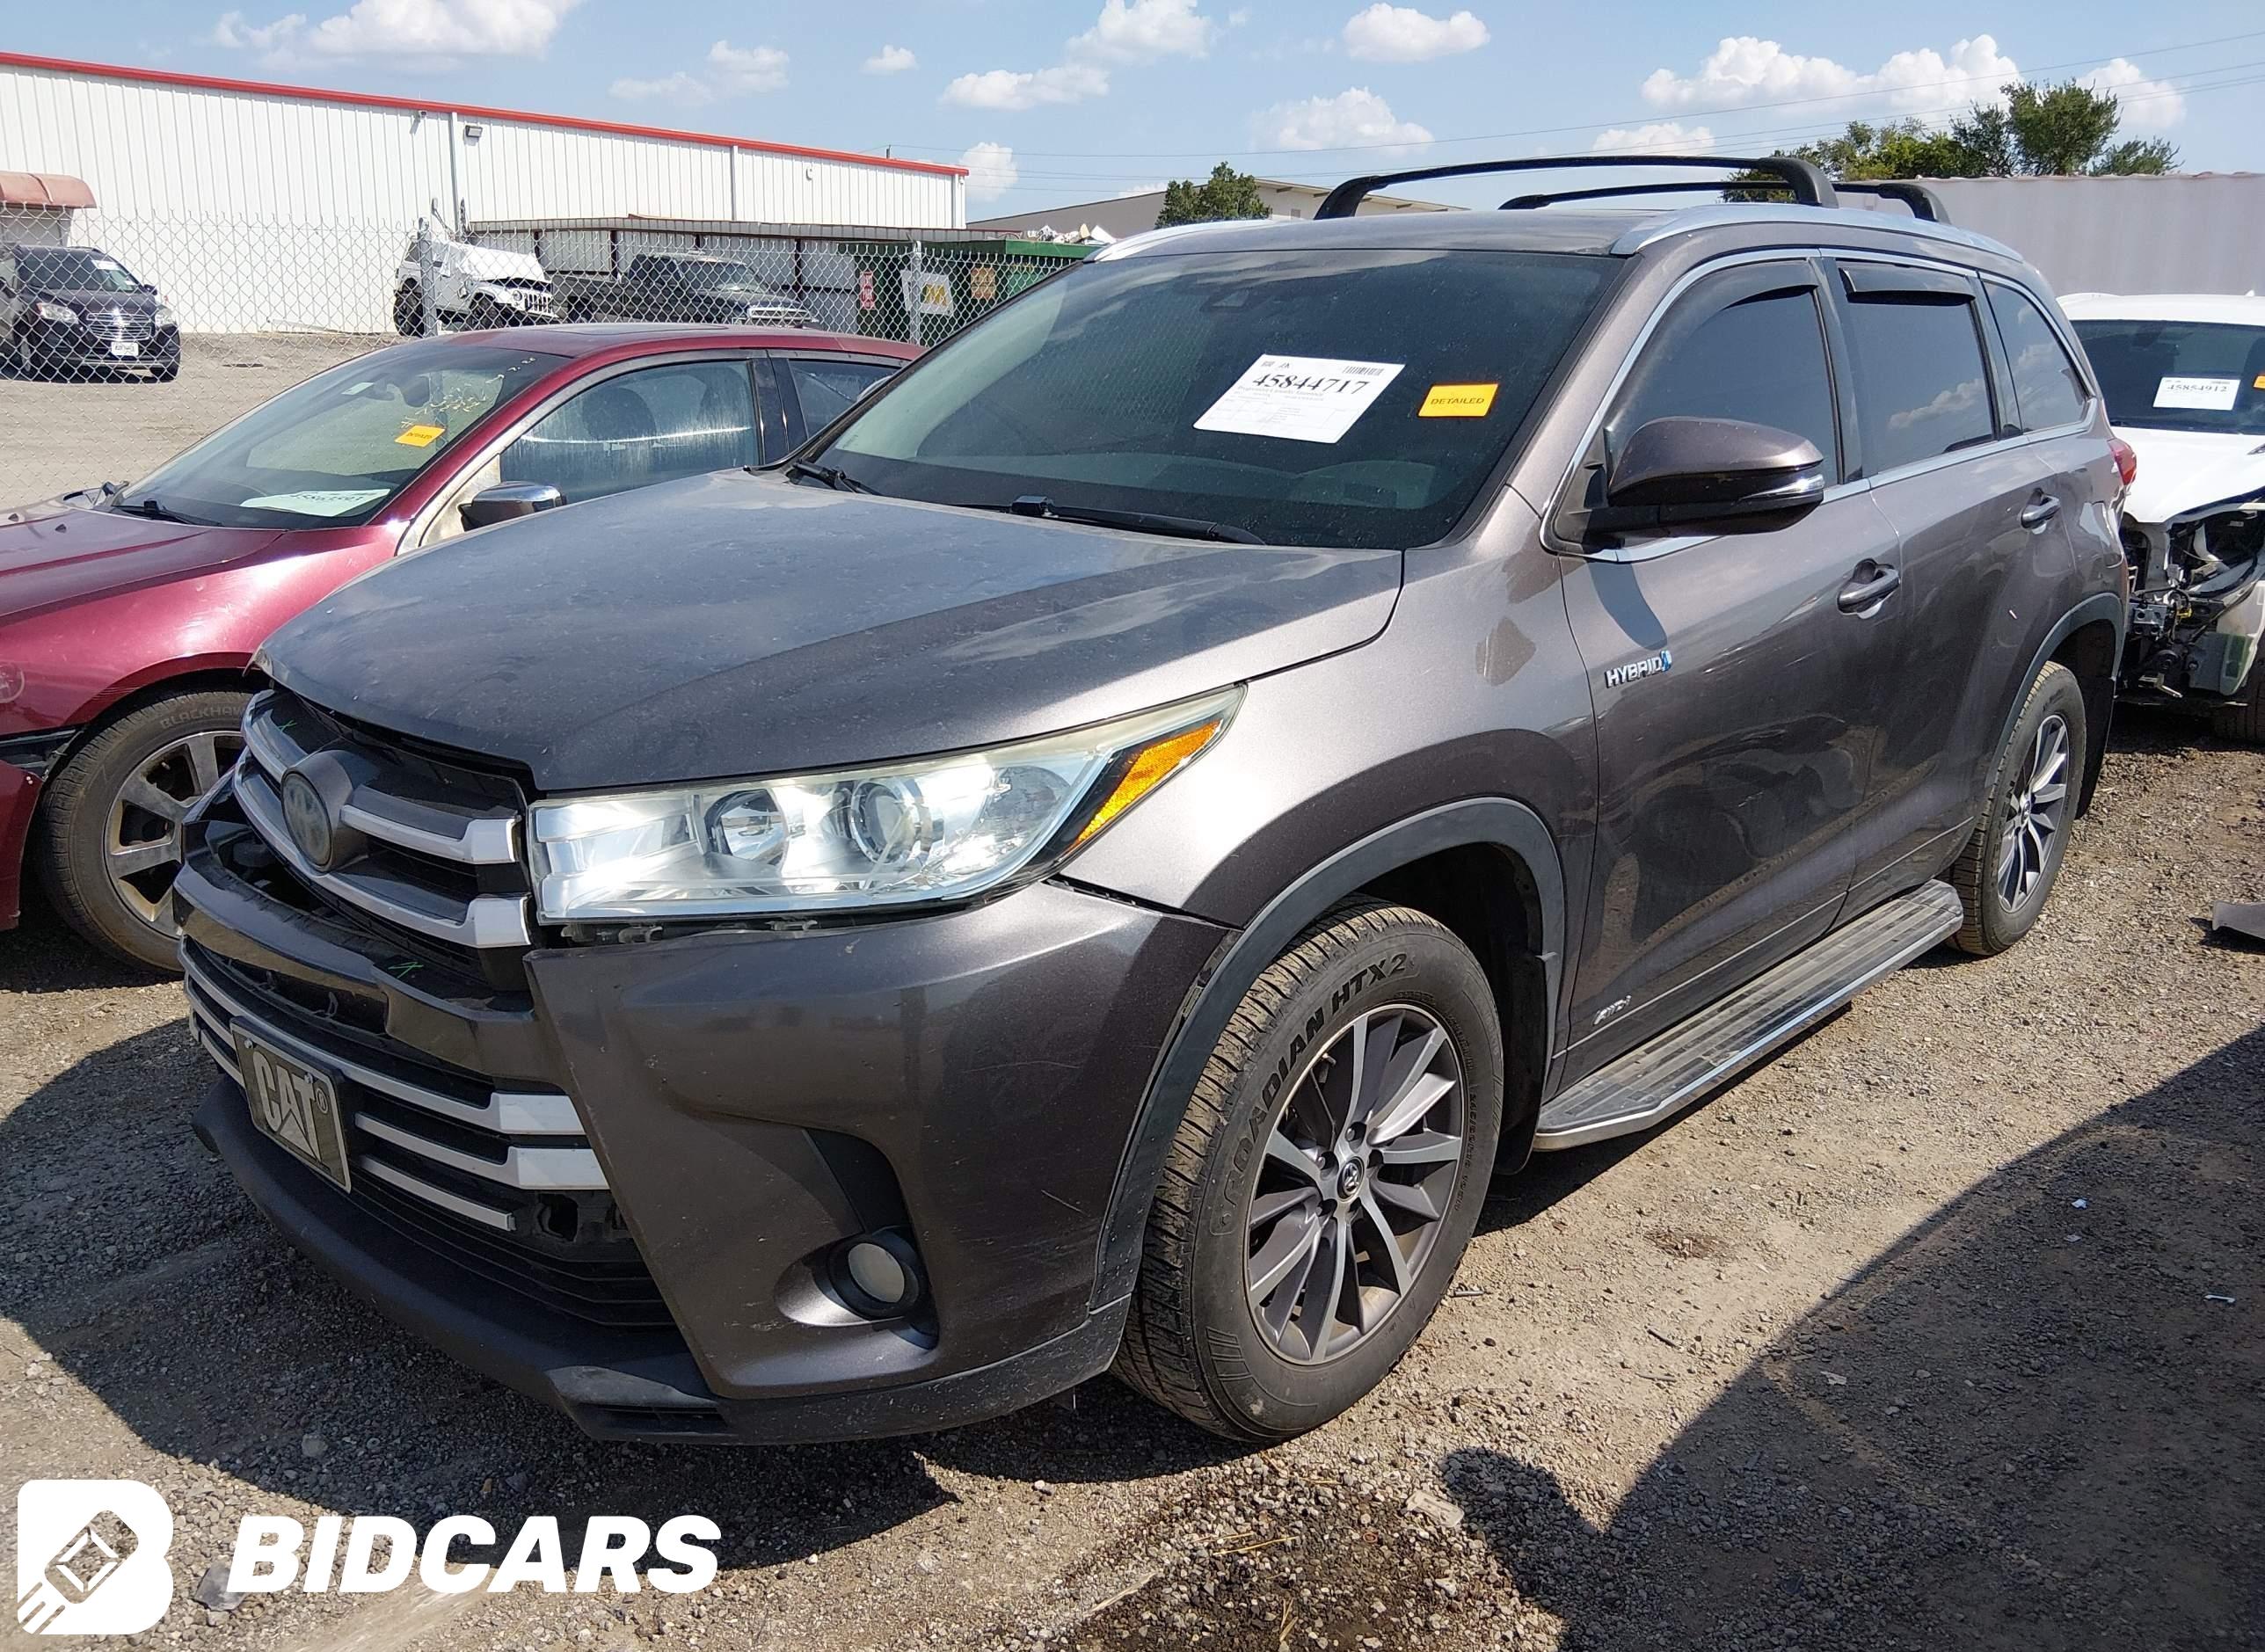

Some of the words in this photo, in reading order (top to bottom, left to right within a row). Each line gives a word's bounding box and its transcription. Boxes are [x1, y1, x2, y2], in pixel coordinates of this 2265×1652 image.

[1252, 373, 1369, 395] 45844717
[1605, 655, 1662, 689] HYBRID
[160, 706, 244, 729] BLACKHAW
[1331, 953, 1407, 1015] HTX2
